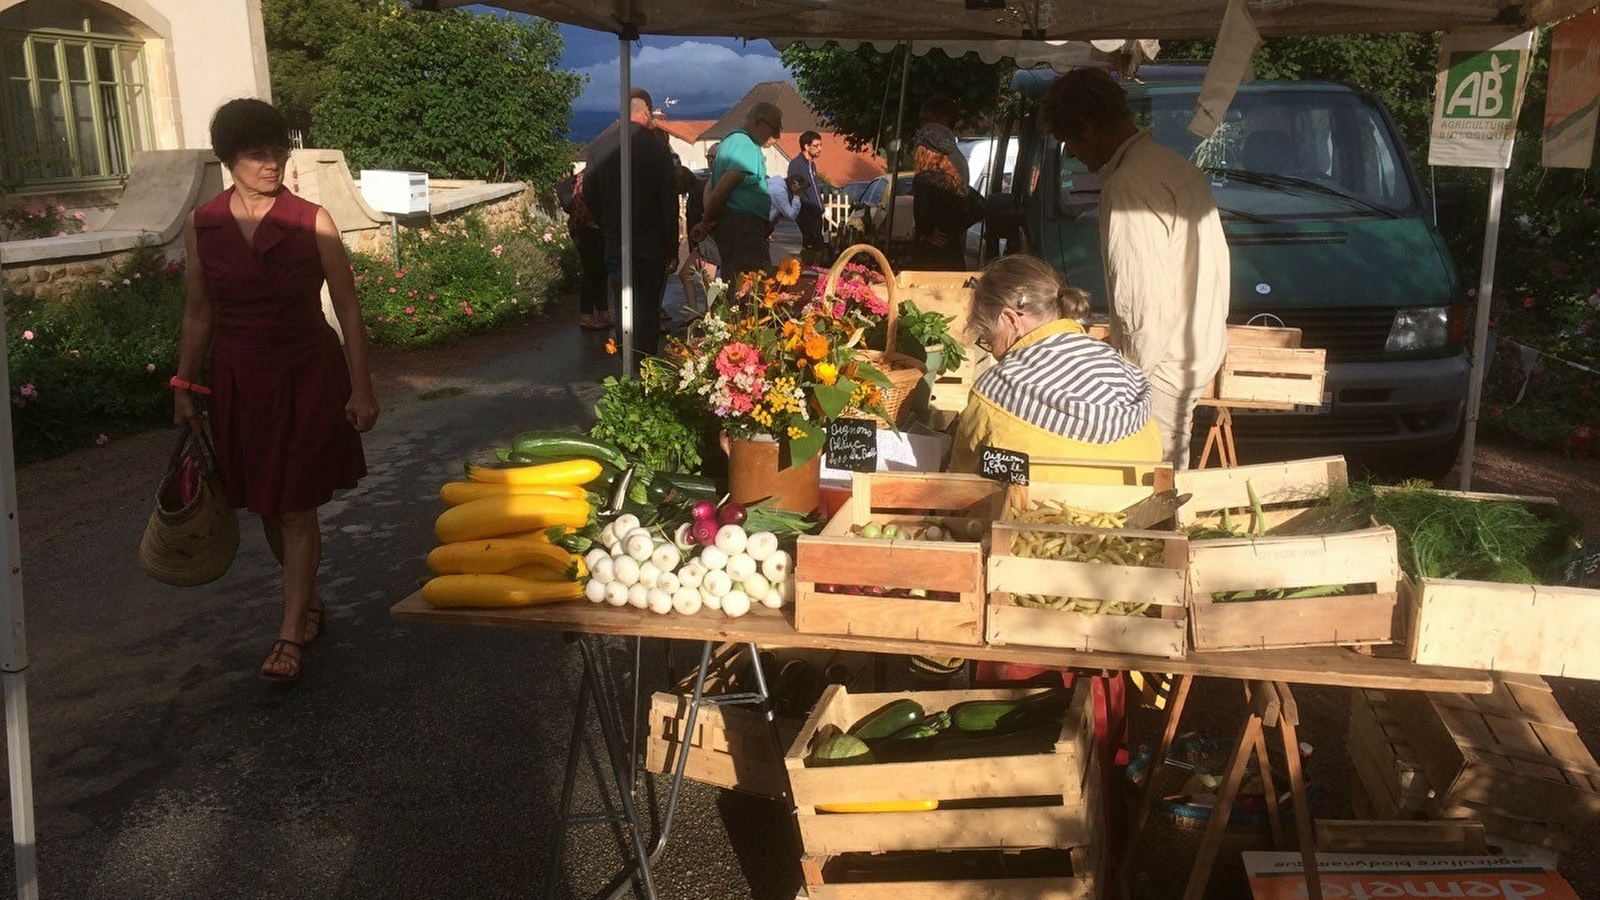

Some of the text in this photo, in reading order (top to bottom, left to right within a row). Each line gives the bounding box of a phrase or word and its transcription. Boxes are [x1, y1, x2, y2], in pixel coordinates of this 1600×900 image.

[1446, 71, 1504, 117] AB
[1441, 120, 1511, 131] AGRICULTURE
[1274, 858, 1523, 869] agriculture biodynamque
